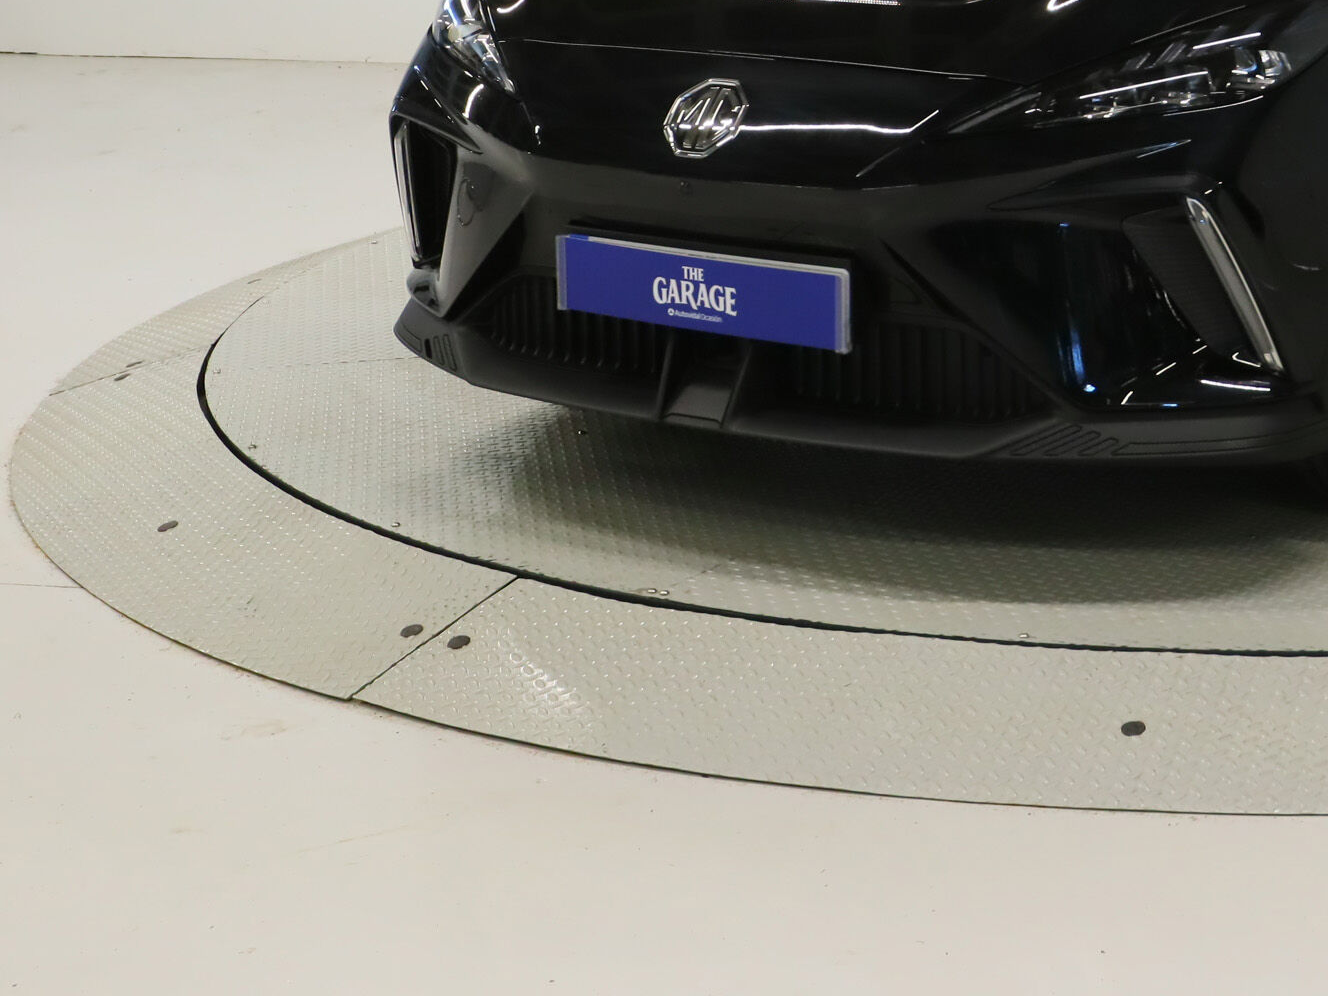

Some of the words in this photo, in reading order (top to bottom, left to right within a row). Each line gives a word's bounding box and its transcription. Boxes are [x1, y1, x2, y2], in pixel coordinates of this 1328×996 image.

[672, 83, 746, 153] MG
[681, 266, 704, 282] THE
[652, 276, 737, 316] GARAGE
